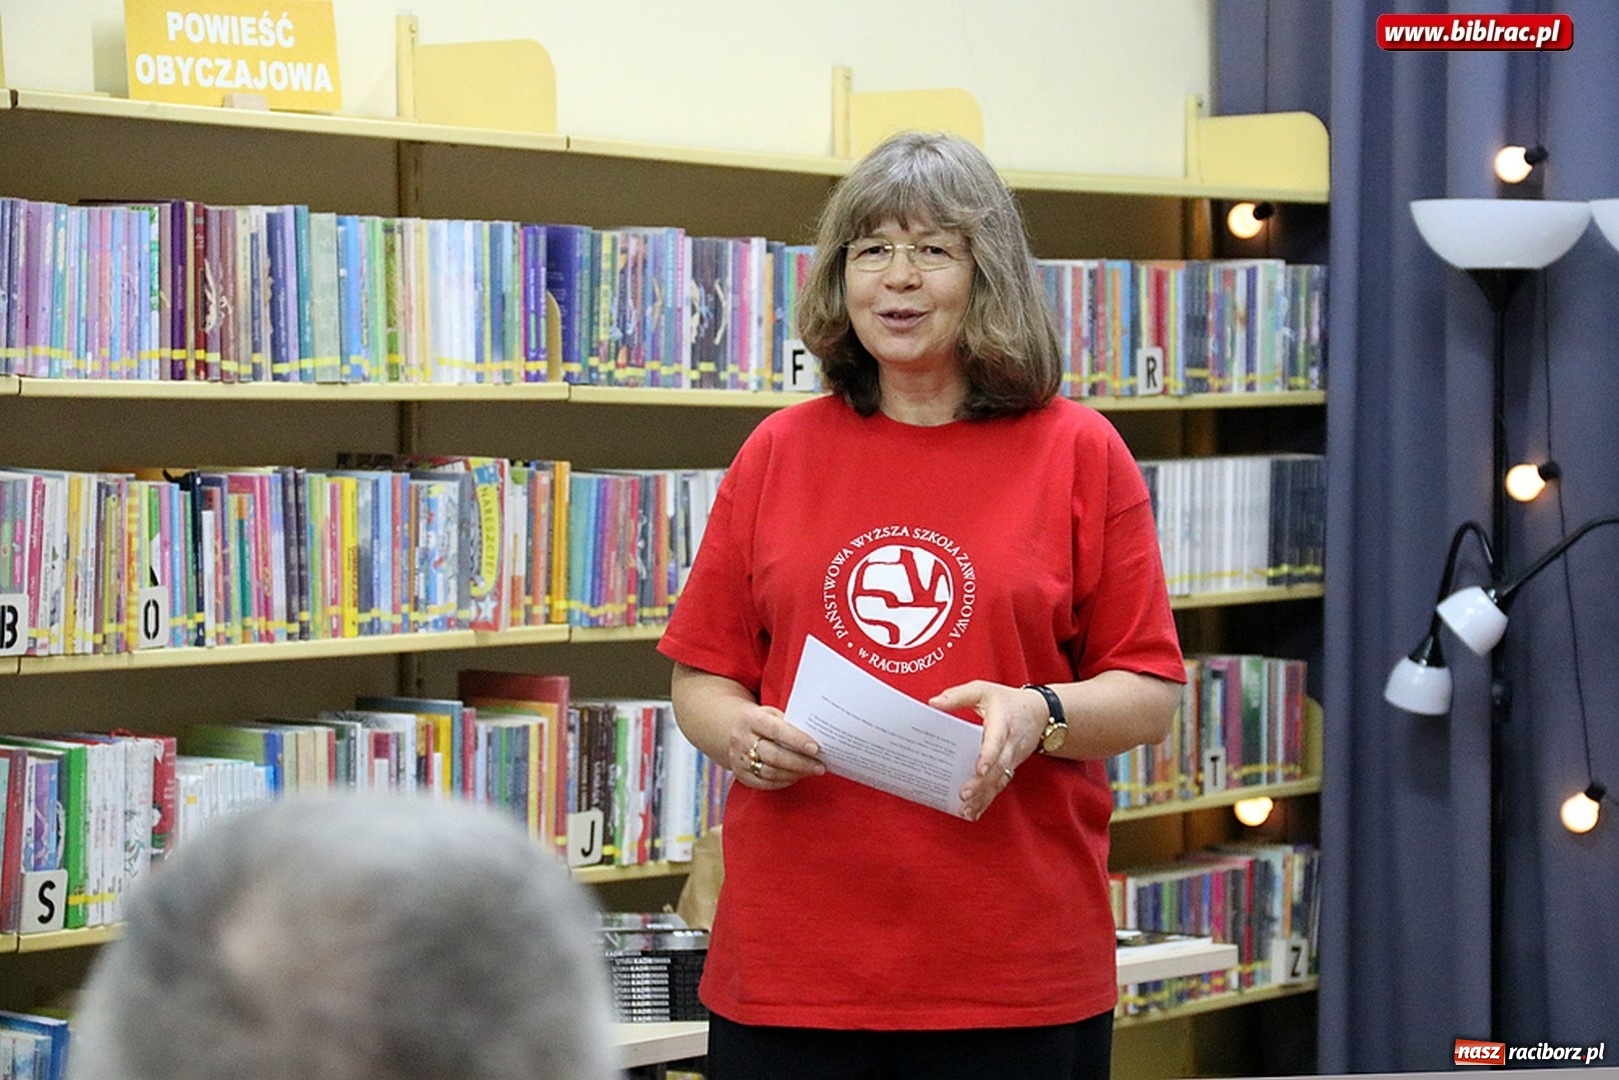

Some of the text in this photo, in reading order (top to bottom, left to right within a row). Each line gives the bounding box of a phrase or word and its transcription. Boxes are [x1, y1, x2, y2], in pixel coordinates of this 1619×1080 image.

[166, 10, 296, 49] POWIEŚĆ
[135, 53, 334, 93] OBYCZAJOWA
[792, 349, 805, 385] F
[1146, 356, 1157, 388] R
[824, 525, 976, 640] PAŃSTWOWA WYŻSZA SZKOŁA ZAWODOWA
[0, 605, 18, 649] B
[868, 647, 945, 674] RACIBORZU
[581, 820, 595, 858] J
[37, 880, 56, 925] S
[1291, 946, 1301, 977] Z
